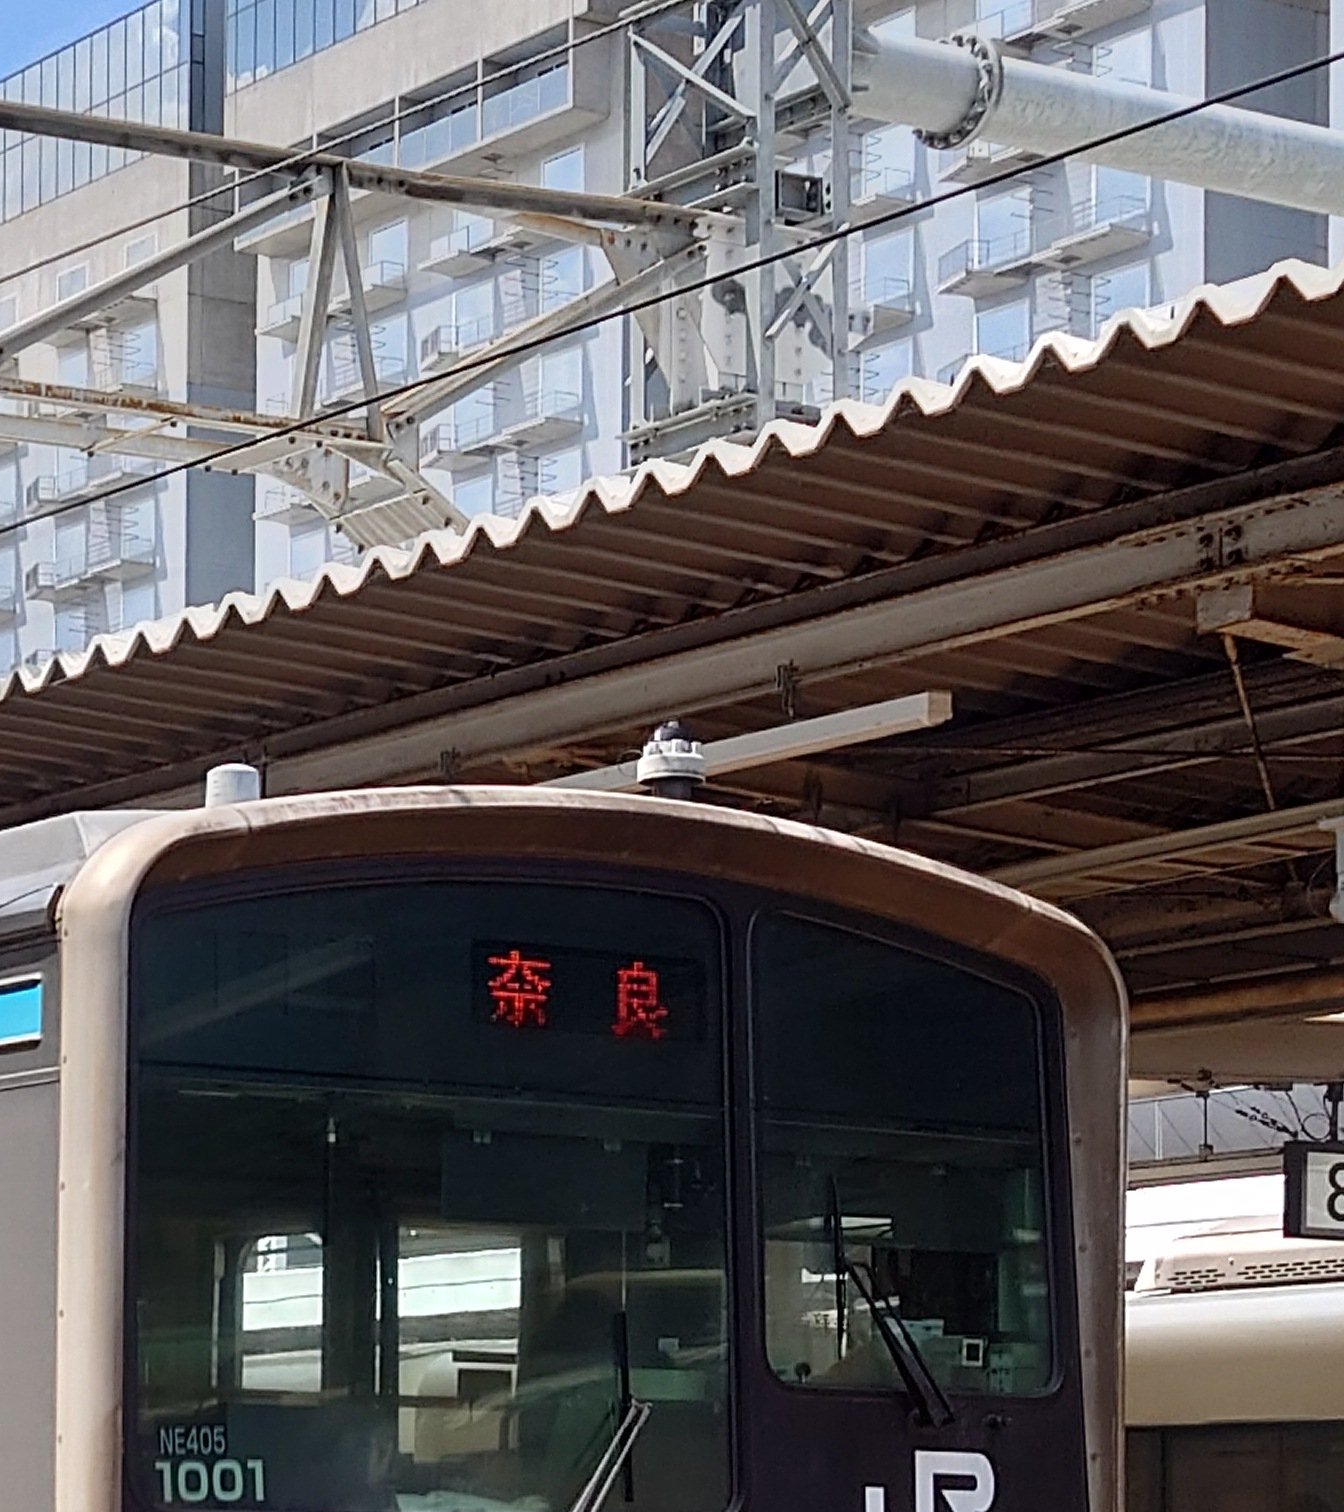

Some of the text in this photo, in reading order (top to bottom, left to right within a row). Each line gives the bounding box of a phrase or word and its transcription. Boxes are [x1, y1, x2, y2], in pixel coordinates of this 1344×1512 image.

[487, 949, 669, 1040] 奈良
[159, 1425, 226, 1455] NE405
[154, 1459, 265, 1503] 1001
